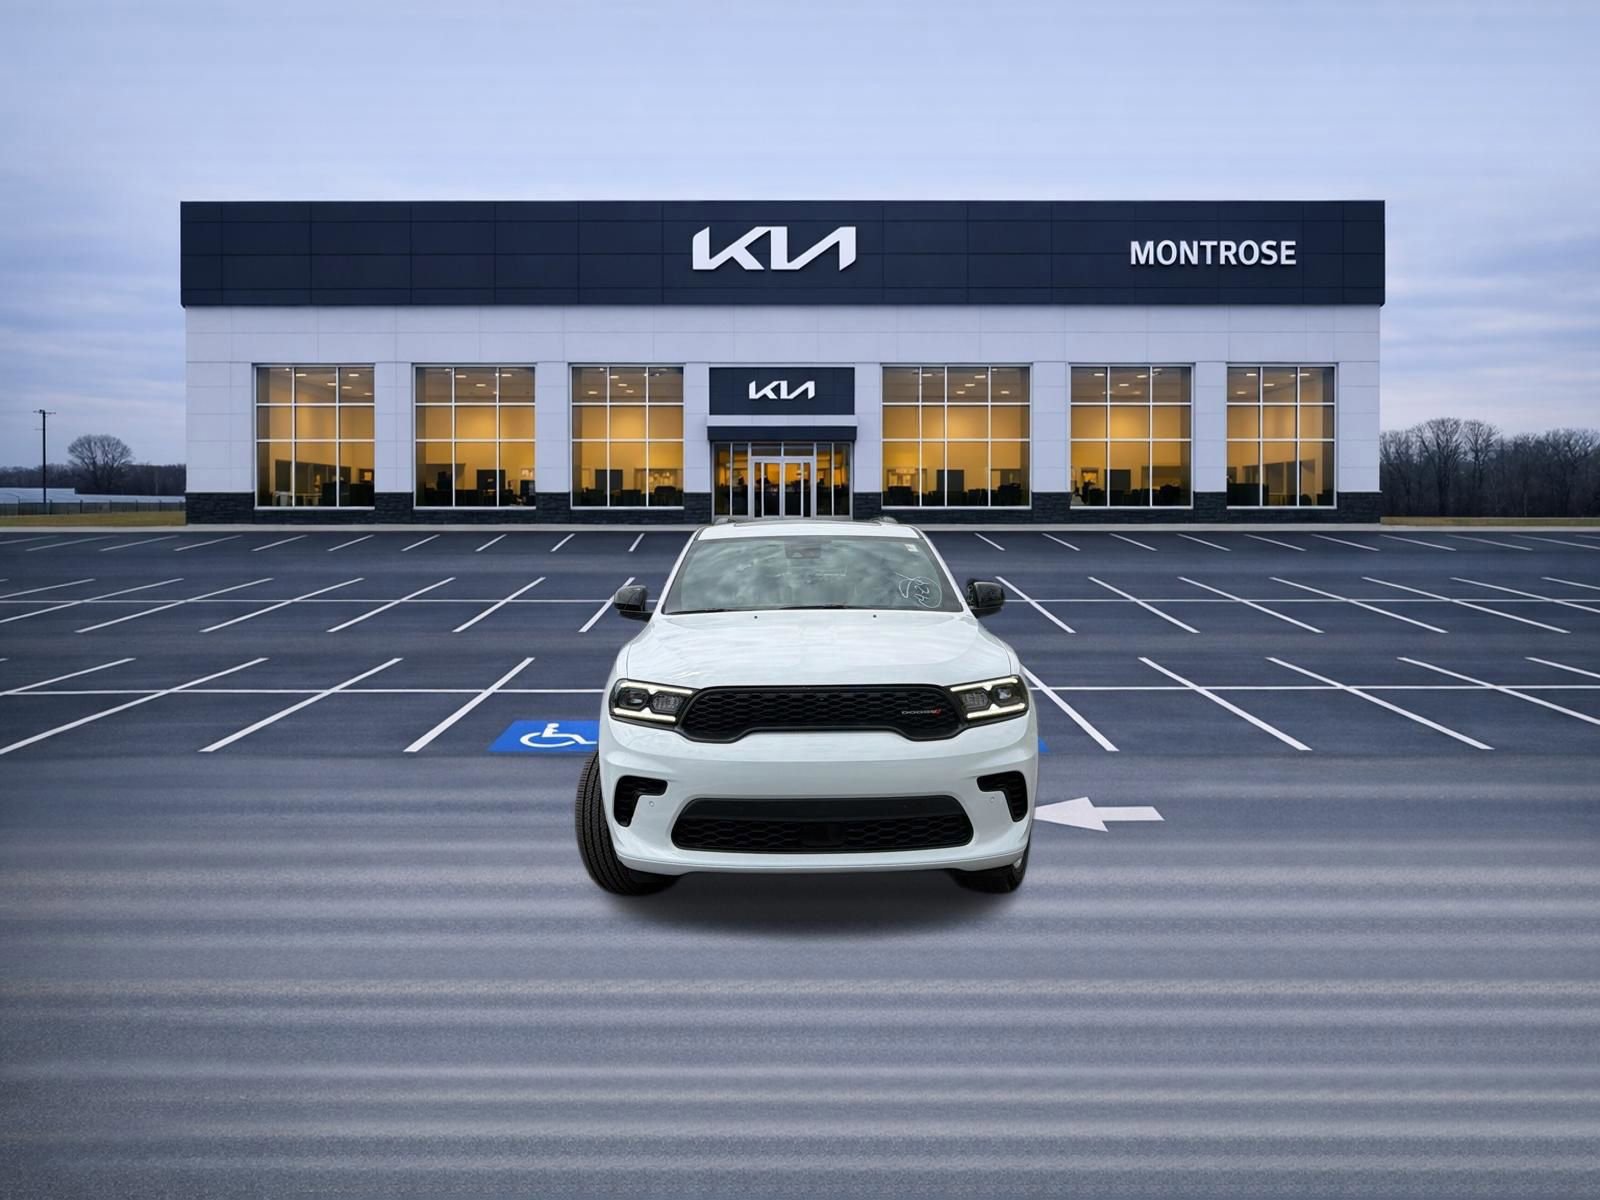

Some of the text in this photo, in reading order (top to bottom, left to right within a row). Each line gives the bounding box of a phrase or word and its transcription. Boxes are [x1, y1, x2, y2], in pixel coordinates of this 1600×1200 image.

[692, 226, 857, 271] KIA
[1130, 239, 1297, 267] MONTROSE
[748, 380, 816, 400] KIA
